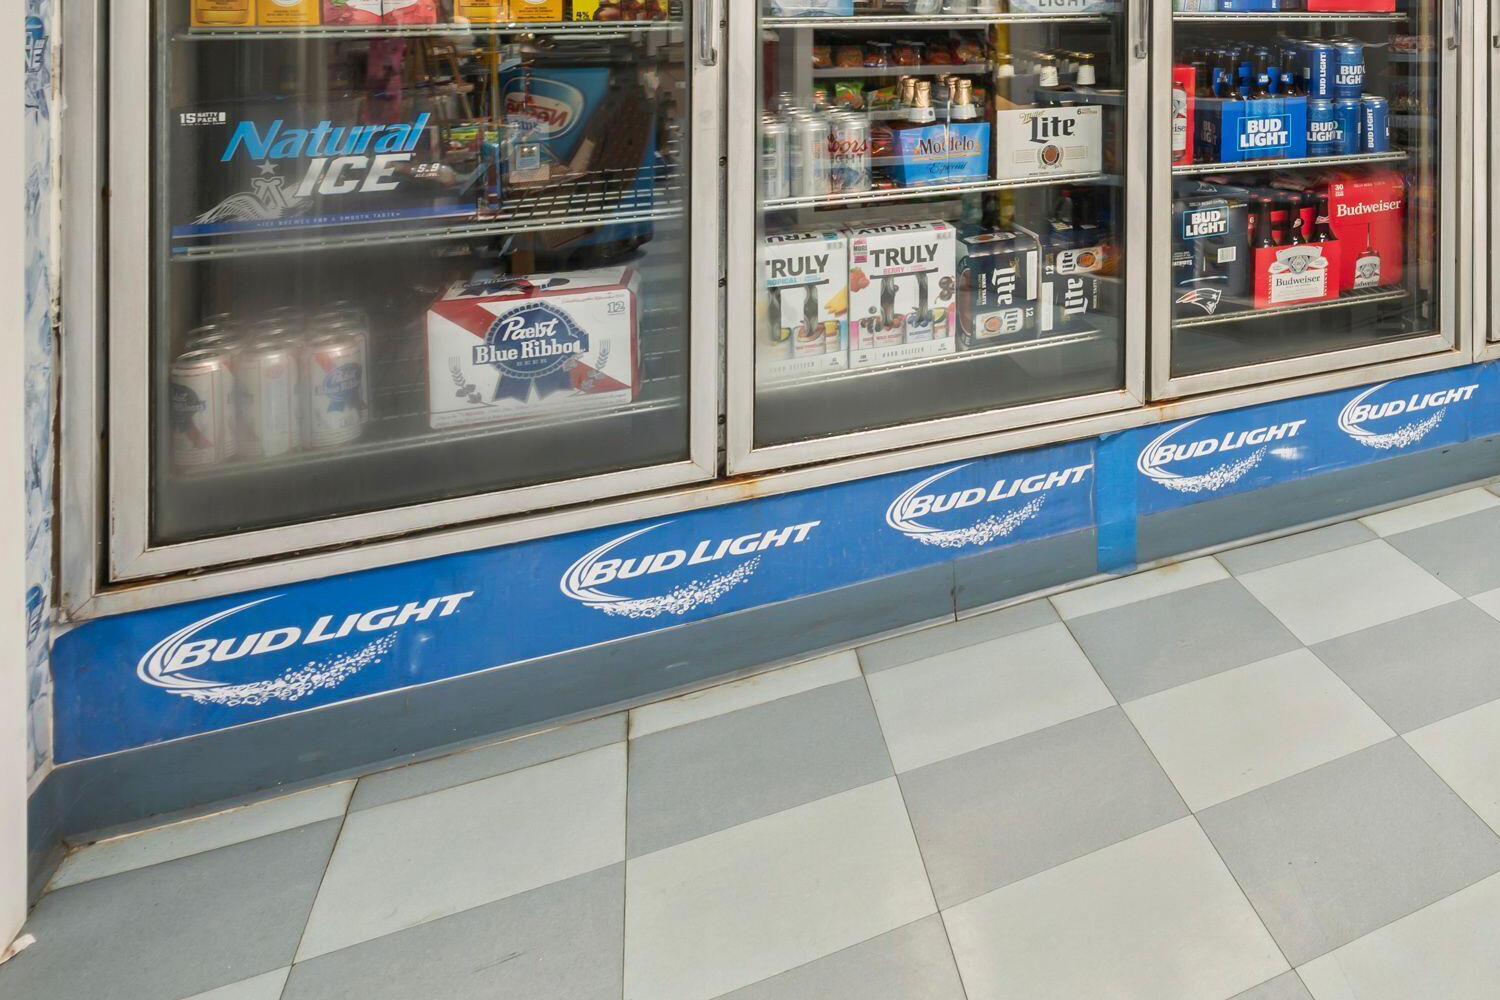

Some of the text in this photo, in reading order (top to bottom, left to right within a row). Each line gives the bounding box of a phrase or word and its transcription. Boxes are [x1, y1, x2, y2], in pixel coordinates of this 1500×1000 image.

[220, 112, 431, 162] Natural
[1029, 115, 1075, 144] Lite
[1240, 130, 1288, 147] LIGHT
[1247, 118, 1282, 132] BUD
[295, 153, 412, 196] ICE
[1191, 210, 1222, 224] BUD
[1336, 200, 1401, 217] Budweiser
[1186, 221, 1226, 236] LIGHT
[869, 244, 938, 268] TRULY
[992, 267, 1016, 305] Lite
[1276, 274, 1320, 286] Budweiser
[476, 343, 518, 364] Blue
[1350, 384, 1479, 424] BUD LIGHT
[1154, 419, 1307, 466] BUD LIGHT
[907, 464, 1095, 518] BUD LIGHT
[585, 521, 821, 586] BUD LIGHT
[162, 591, 475, 674] BUD LIGHT
